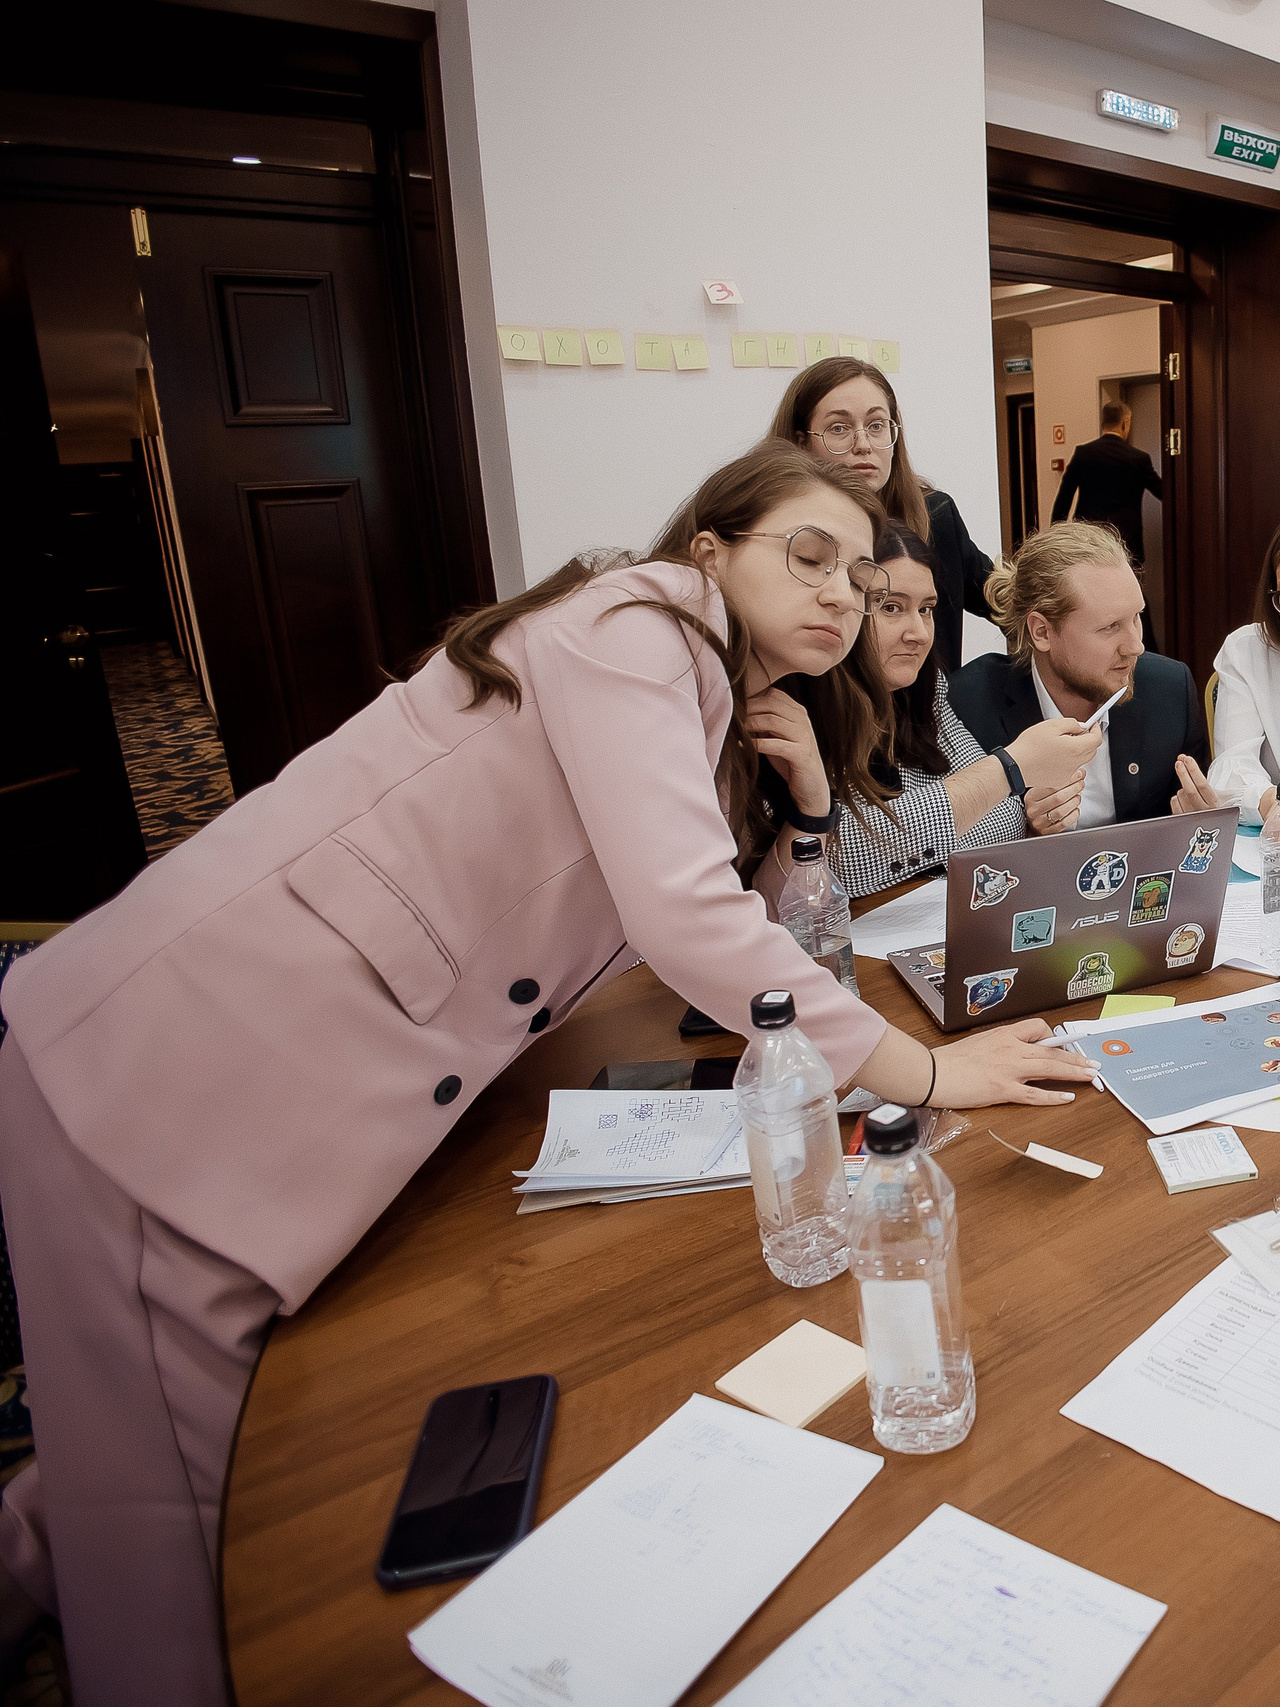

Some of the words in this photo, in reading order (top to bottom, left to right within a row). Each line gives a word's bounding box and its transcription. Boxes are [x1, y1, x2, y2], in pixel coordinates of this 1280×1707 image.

[1223, 129, 1277, 156] ВЫХОД
[1231, 146, 1264, 162] EXIT
[708, 283, 734, 301] 3
[1070, 910, 1119, 930] ASUS
[1070, 974, 1112, 991] DOGECOIN
[1125, 1064, 1160, 1075] Памятка
[1160, 1061, 1175, 1069] для
[1132, 1067, 1180, 1082] модератора
[1180, 1060, 1208, 1071] группы
